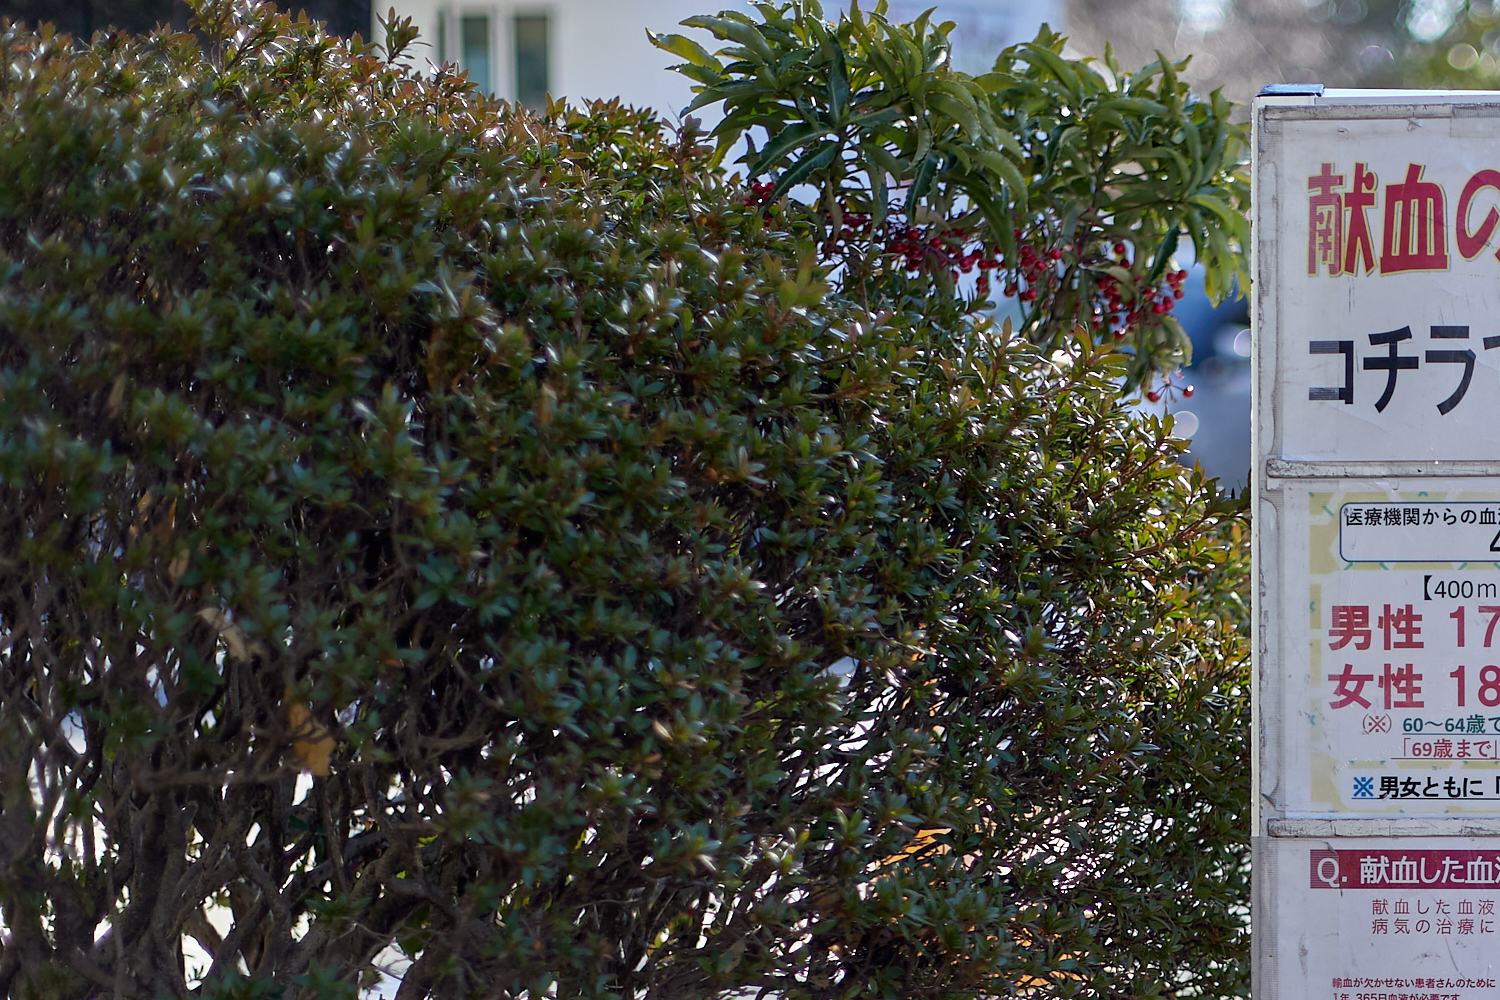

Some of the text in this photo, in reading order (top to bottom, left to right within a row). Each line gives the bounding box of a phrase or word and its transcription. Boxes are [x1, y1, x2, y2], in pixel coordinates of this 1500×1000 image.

[1327, 604, 1425, 651] 男性
[1327, 664, 1425, 711] 女性
[1316, 857, 1348, 887] Q.
[1332, 977, 1496, 988] 輸血が欠かせない患者さんのために
